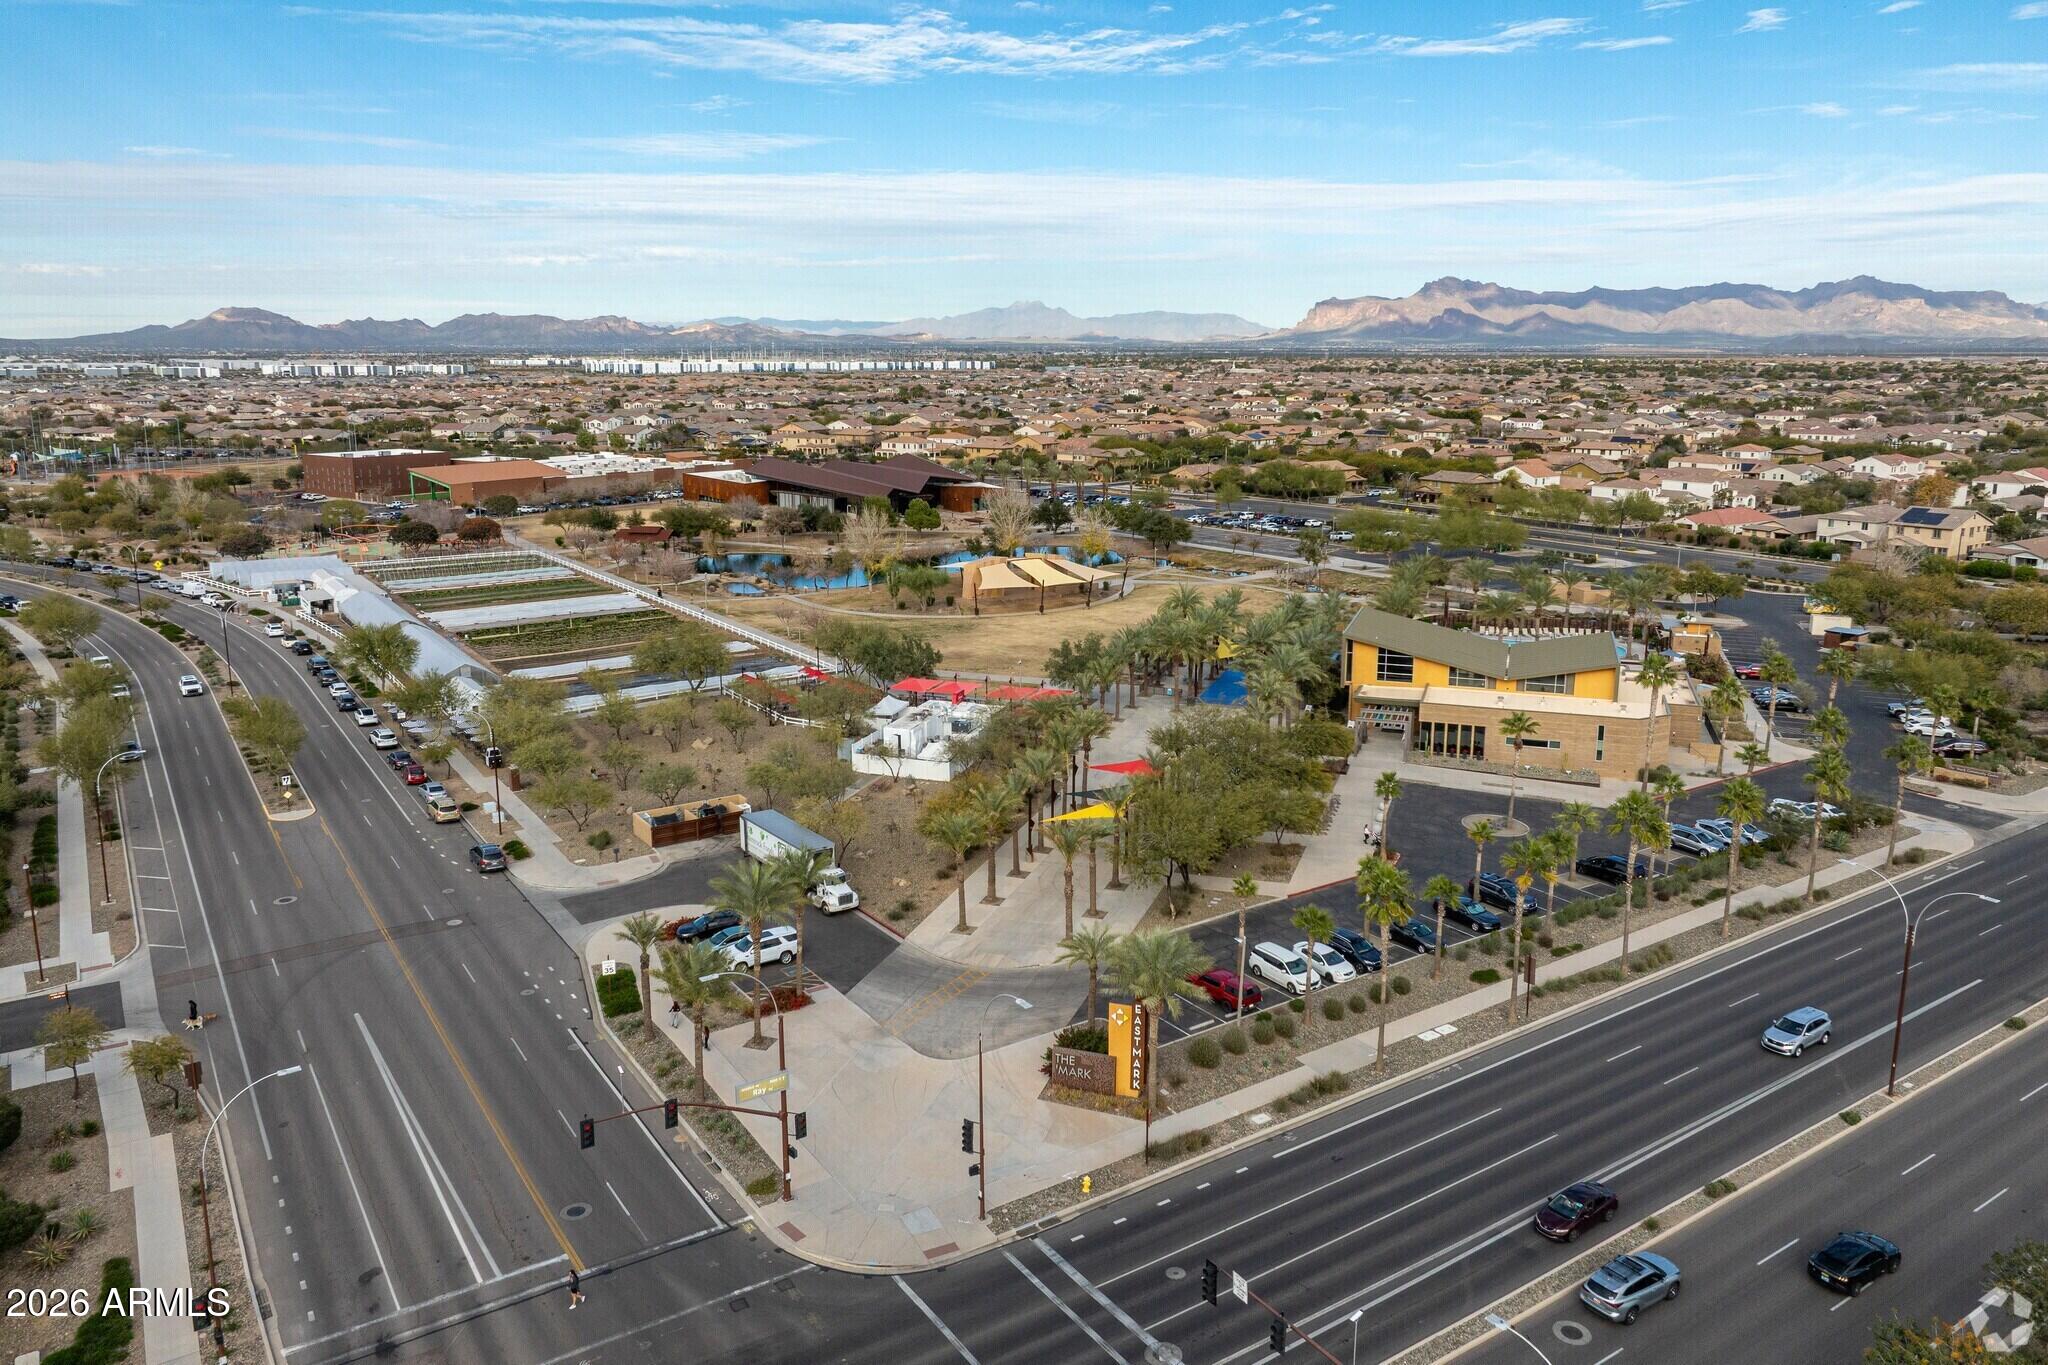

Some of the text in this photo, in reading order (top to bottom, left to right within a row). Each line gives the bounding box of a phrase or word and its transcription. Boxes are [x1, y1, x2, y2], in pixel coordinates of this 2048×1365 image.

[1132, 1004, 1142, 1090] EASTMARK
[1055, 1053, 1076, 1066] THE
[1055, 1064, 1092, 1080] 'MARK
[752, 1087, 766, 1096] Ray
